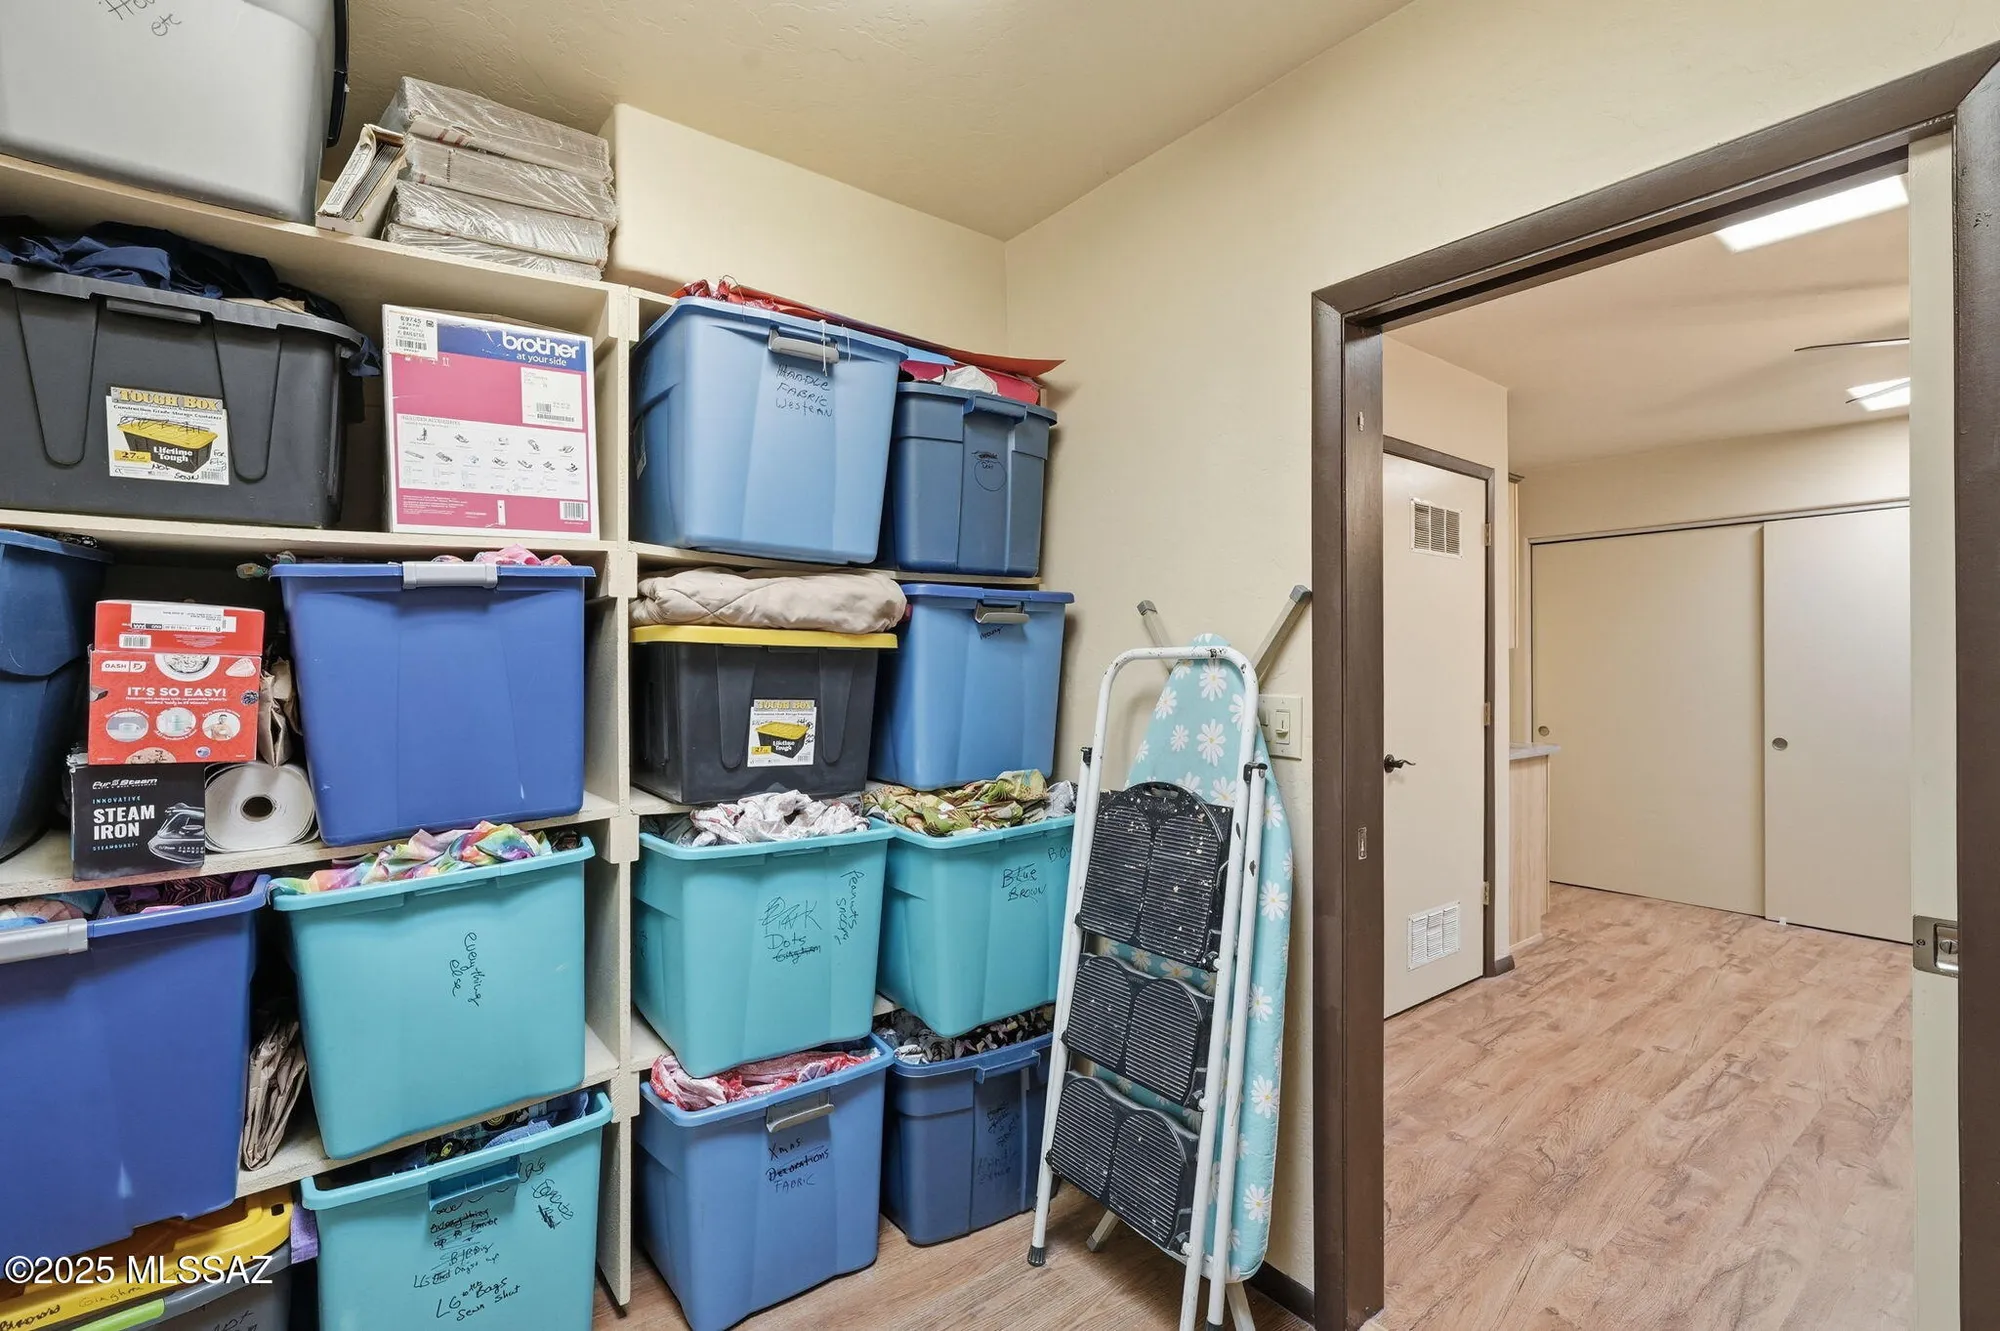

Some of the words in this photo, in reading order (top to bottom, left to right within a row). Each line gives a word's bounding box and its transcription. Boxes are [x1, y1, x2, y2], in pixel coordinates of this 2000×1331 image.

[502, 329, 579, 358] brother
[527, 355, 548, 364] your
[549, 357, 567, 367] side
[119, 389, 179, 407] TOUGH
[183, 397, 220, 411] BOX
[121, 451, 136, 459] 27
[153, 446, 193, 457] Lifetime
[159, 453, 189, 464] Tough
[127, 687, 156, 697] IT'S
[159, 687, 180, 697] SO
[184, 688, 227, 698] EASY!
[93, 805, 155, 823] STEAM
[93, 822, 140, 840] IRON
